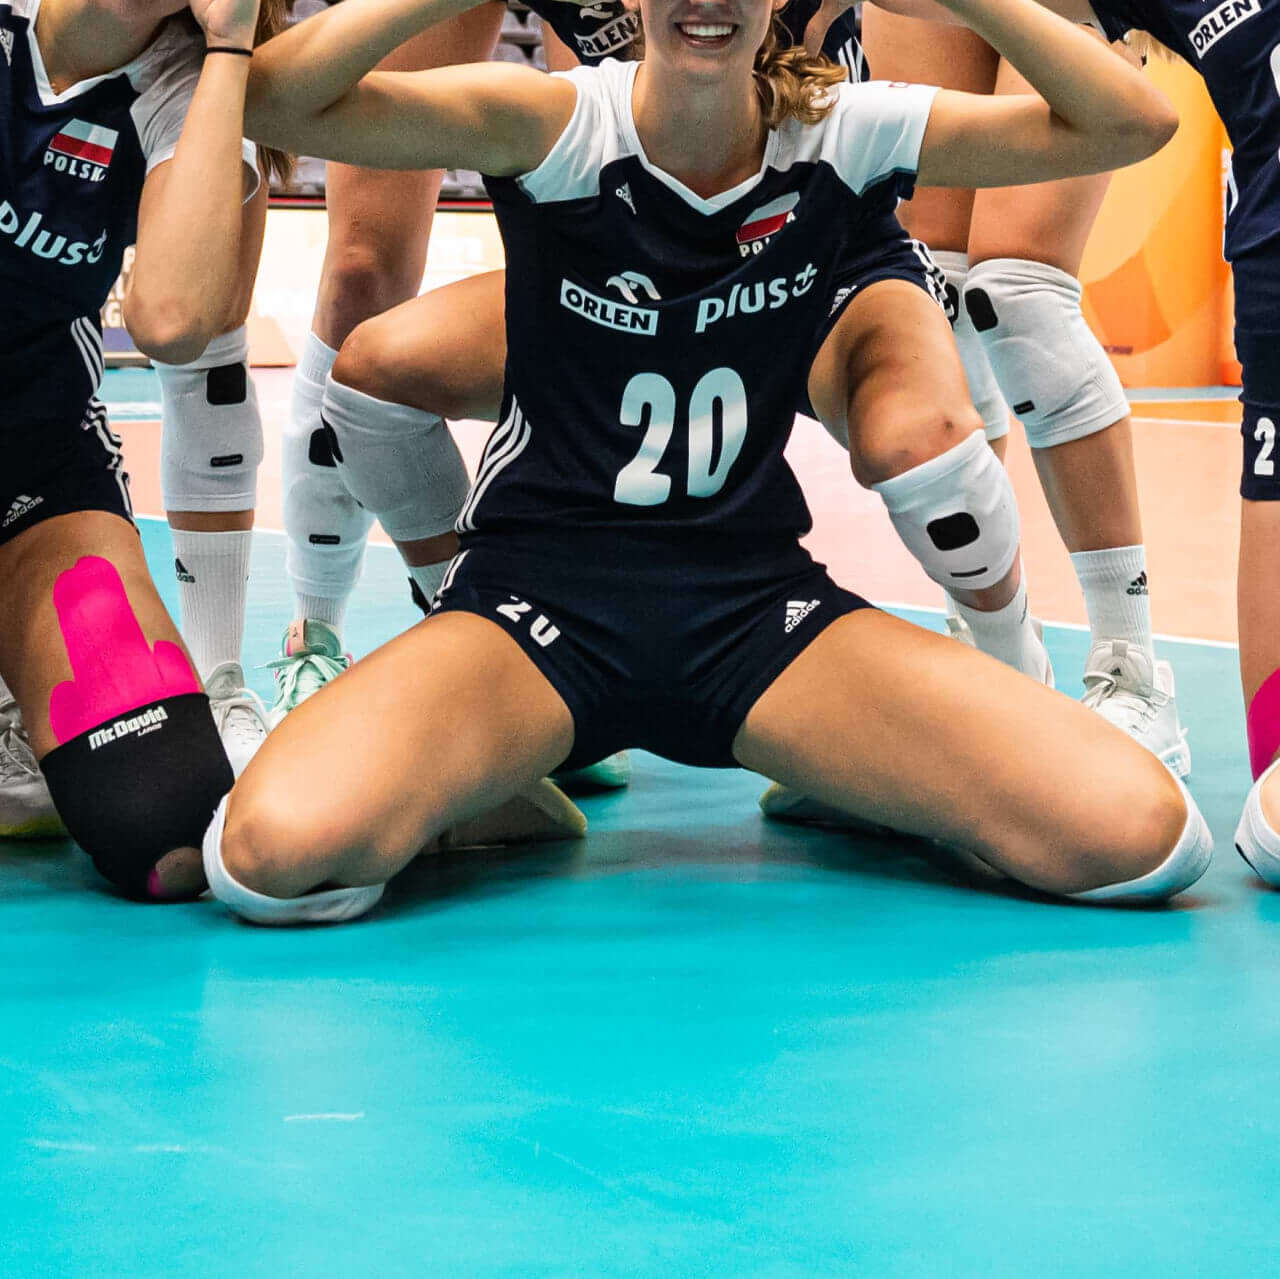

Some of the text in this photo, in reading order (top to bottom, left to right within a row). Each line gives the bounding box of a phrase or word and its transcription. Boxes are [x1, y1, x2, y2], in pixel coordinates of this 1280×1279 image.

[43, 149, 107, 183] POLSK
[565, 287, 651, 332] ORLEN
[694, 275, 788, 334] plus
[613, 367, 748, 507] 20
[783, 599, 821, 634] adidas
[87, 705, 169, 751] McDavid
